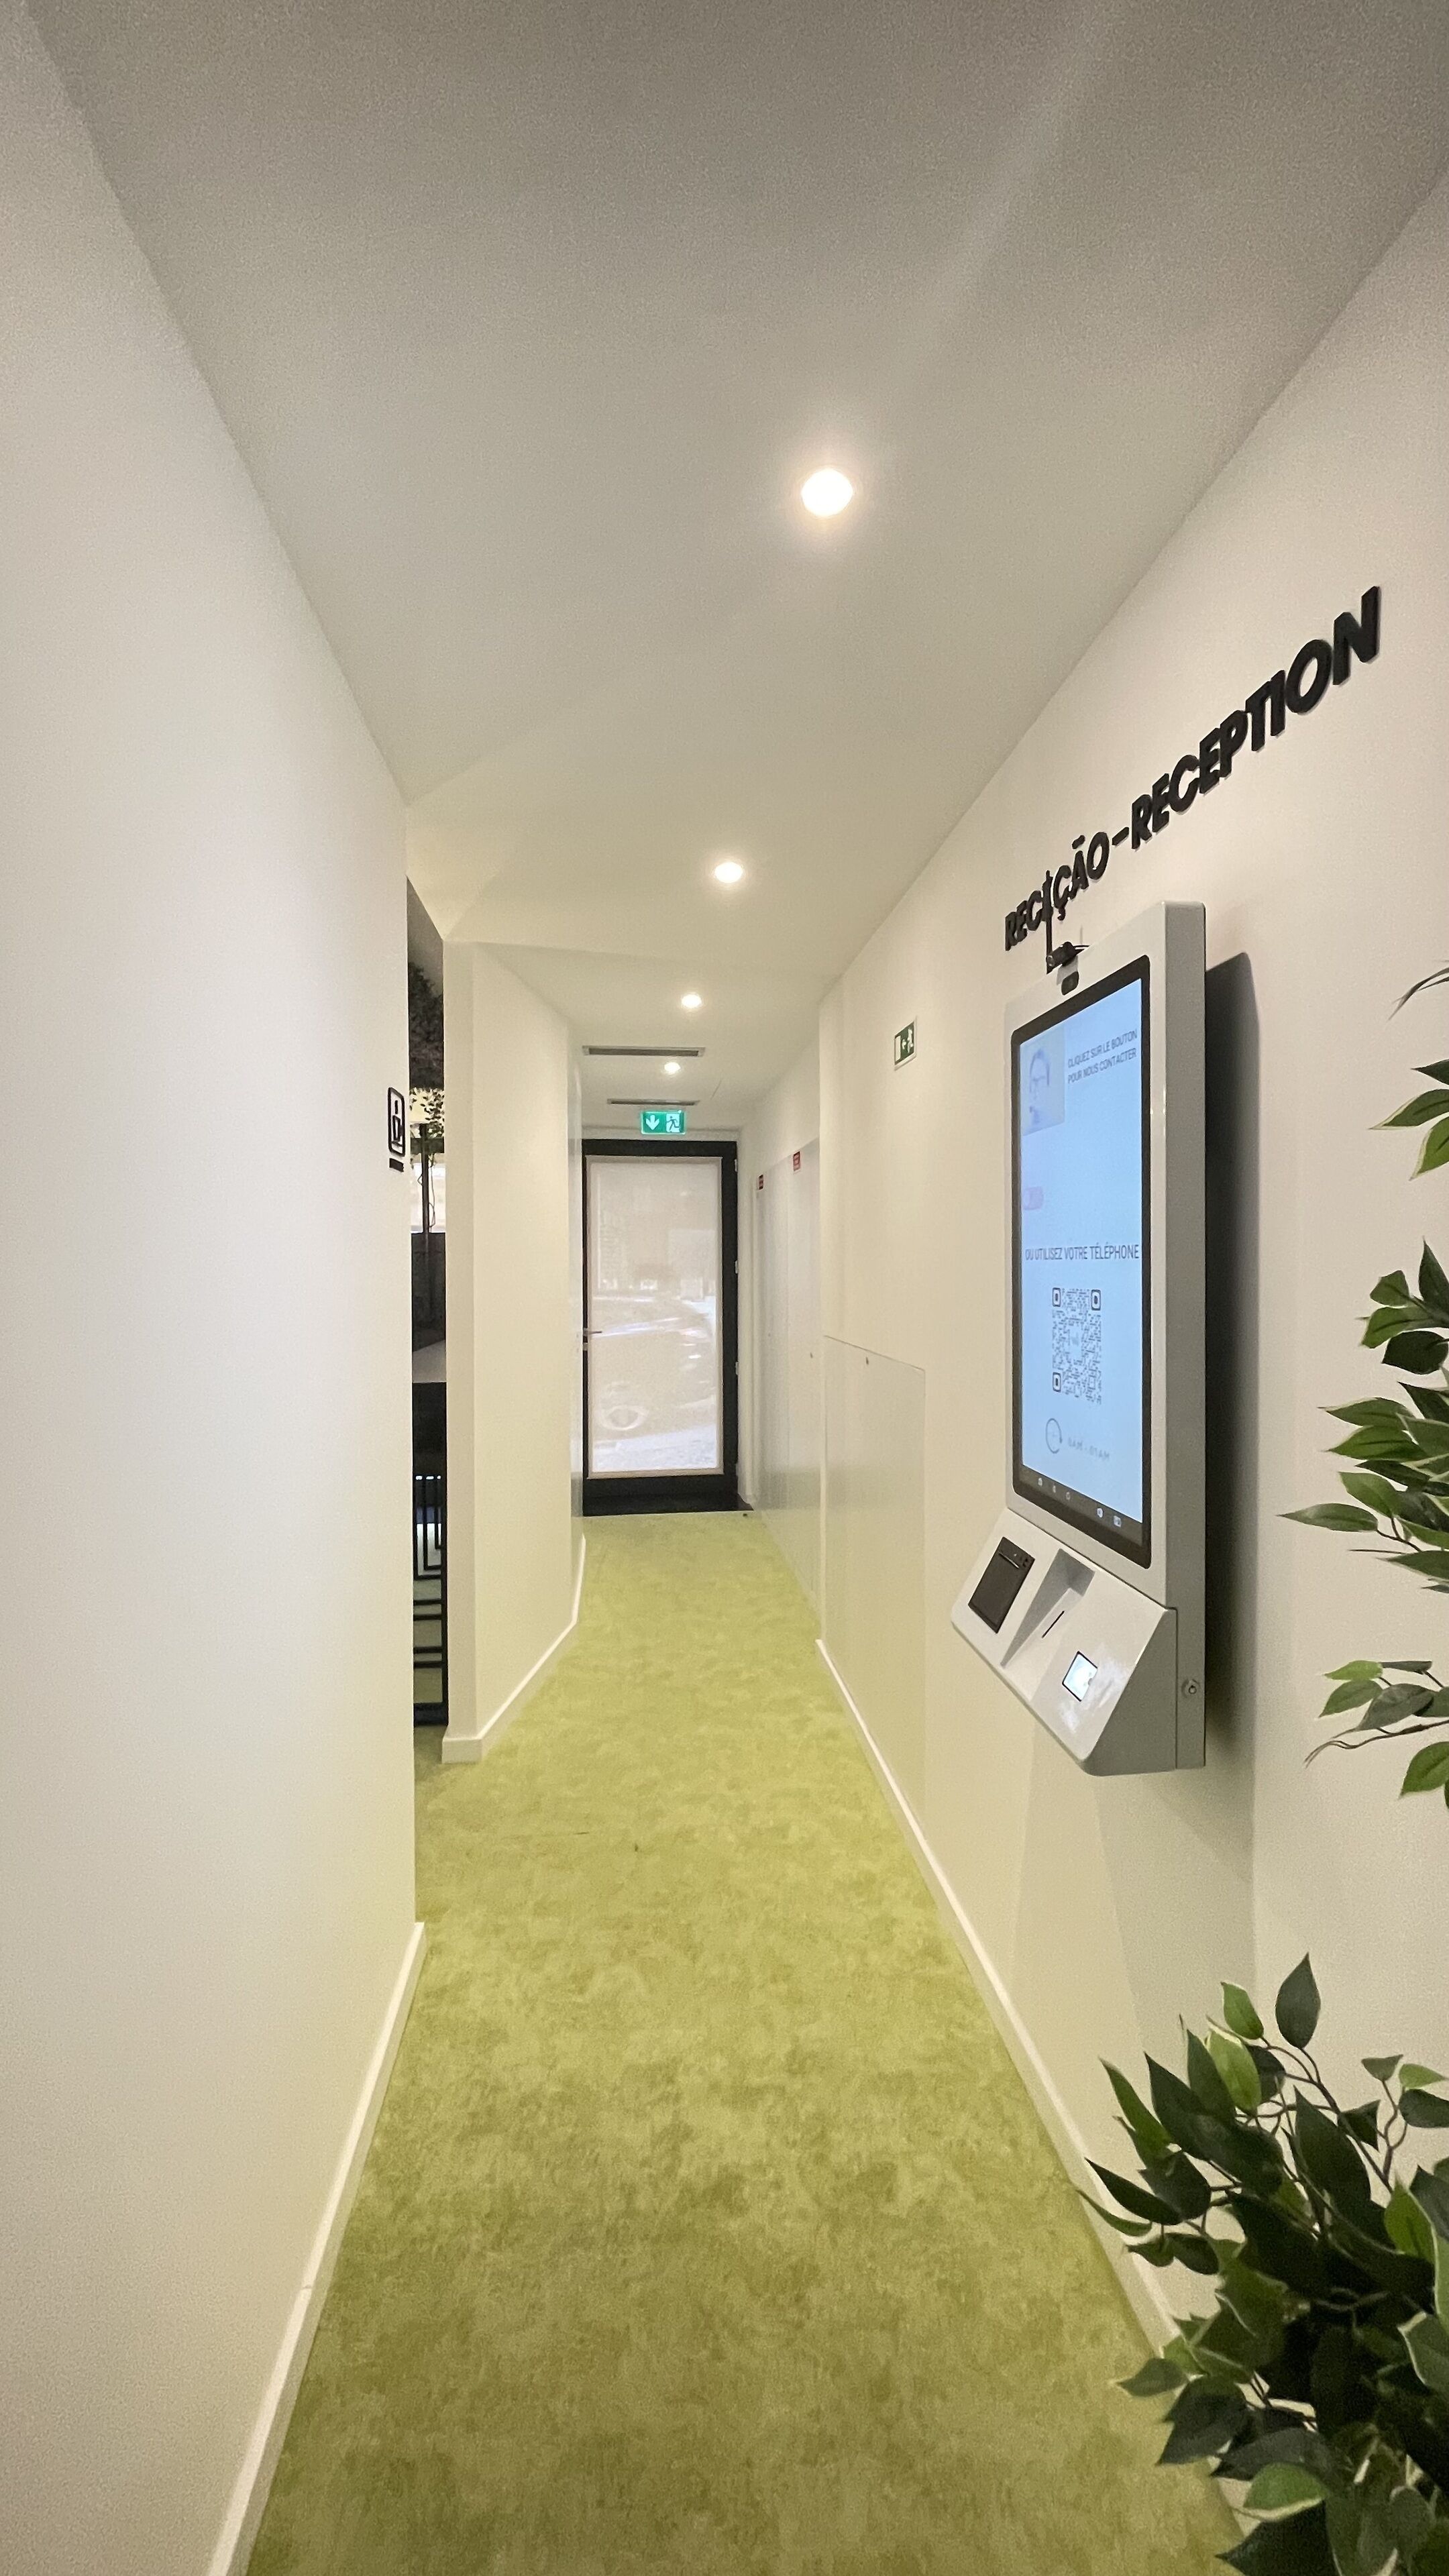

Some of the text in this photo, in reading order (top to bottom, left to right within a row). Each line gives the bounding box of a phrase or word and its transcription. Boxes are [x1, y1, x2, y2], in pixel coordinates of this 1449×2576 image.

[1005, 831, 1110, 951] RECÇÃO
[1131, 585, 1380, 851] RECEPTION
[1111, 1028, 1138, 1049] BOUTON
[1068, 1047, 1137, 1084] POUR NOUS CONTACTER
[1064, 1246, 1088, 1260] VOTRE
[1089, 1242, 1140, 1259] TÉLÉPHONE
